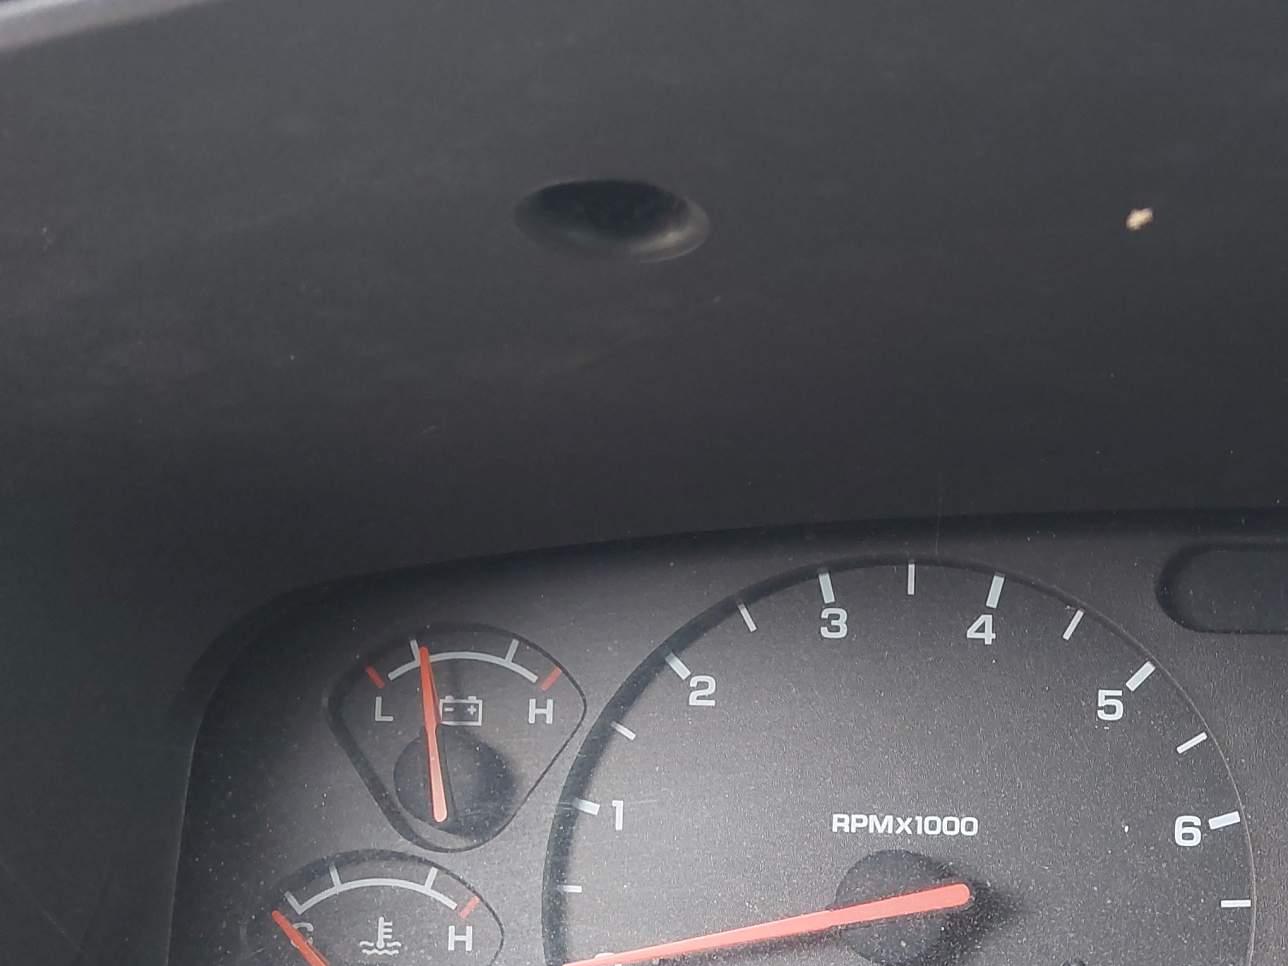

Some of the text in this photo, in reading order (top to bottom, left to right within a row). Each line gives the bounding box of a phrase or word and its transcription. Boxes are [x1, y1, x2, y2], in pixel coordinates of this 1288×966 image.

[820, 607, 848, 639] 3
[966, 614, 996, 645] 4
[688, 675, 717, 707] 2
[1098, 689, 1124, 721] 5
[374, 696, 394, 722] L
[528, 698, 554, 724] H
[611, 800, 624, 831] 1
[1174, 815, 1202, 848] 6
[448, 926, 473, 951] H
